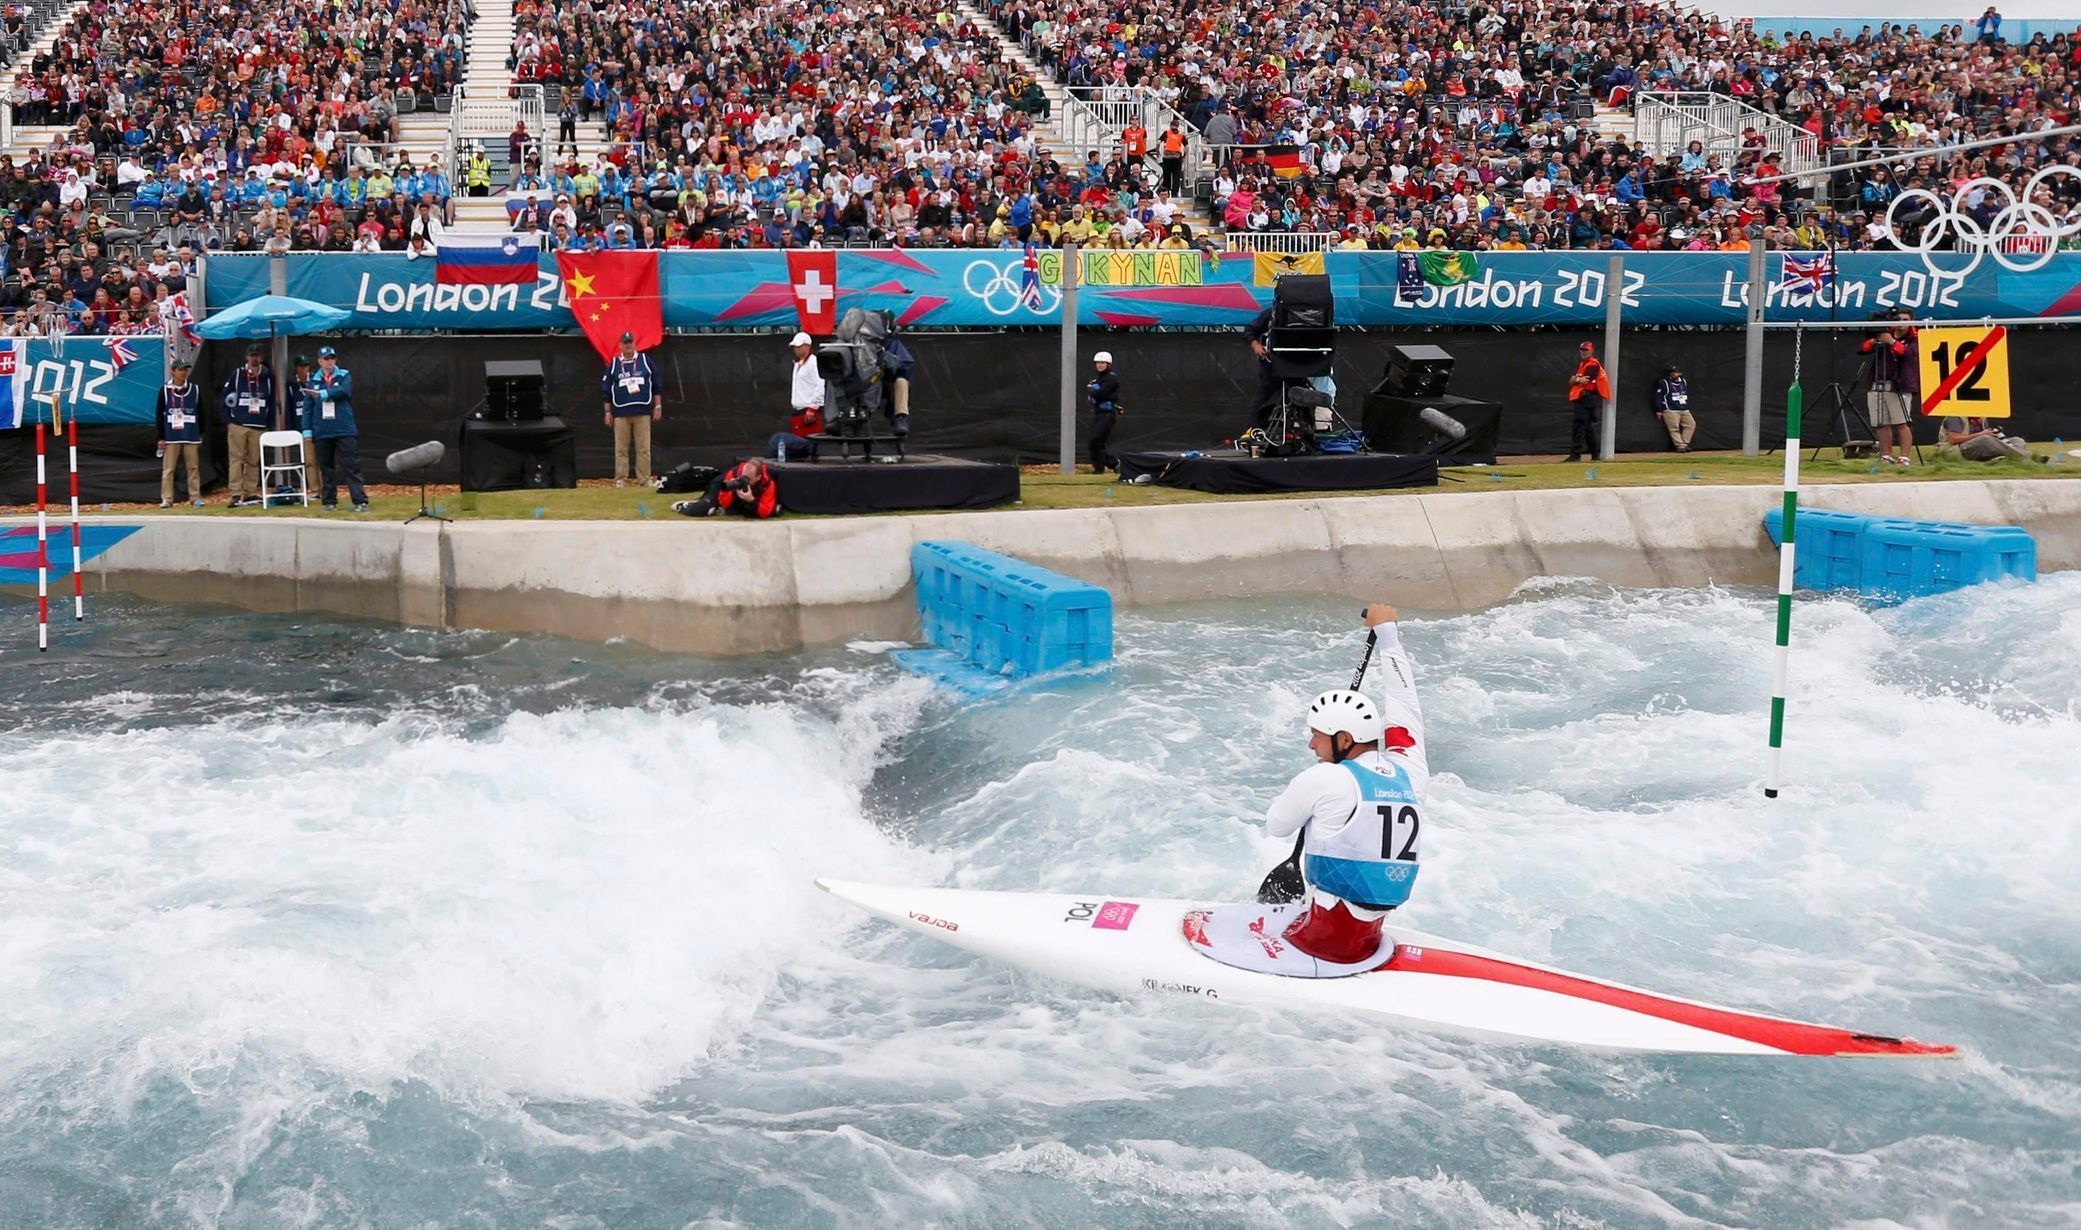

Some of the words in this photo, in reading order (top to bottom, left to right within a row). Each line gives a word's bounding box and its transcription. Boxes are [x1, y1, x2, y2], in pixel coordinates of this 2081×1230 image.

[1039, 252, 1201, 285] GKYNAN
[356, 272, 519, 312] London
[1554, 269, 1645, 308] 202
[1876, 269, 1965, 308] 2012
[24, 359, 114, 404] 012
[1931, 341, 1990, 401] 12
[1375, 788, 1402, 799] London
[1377, 805, 1419, 861] 12
[1064, 902, 1098, 922] POL
